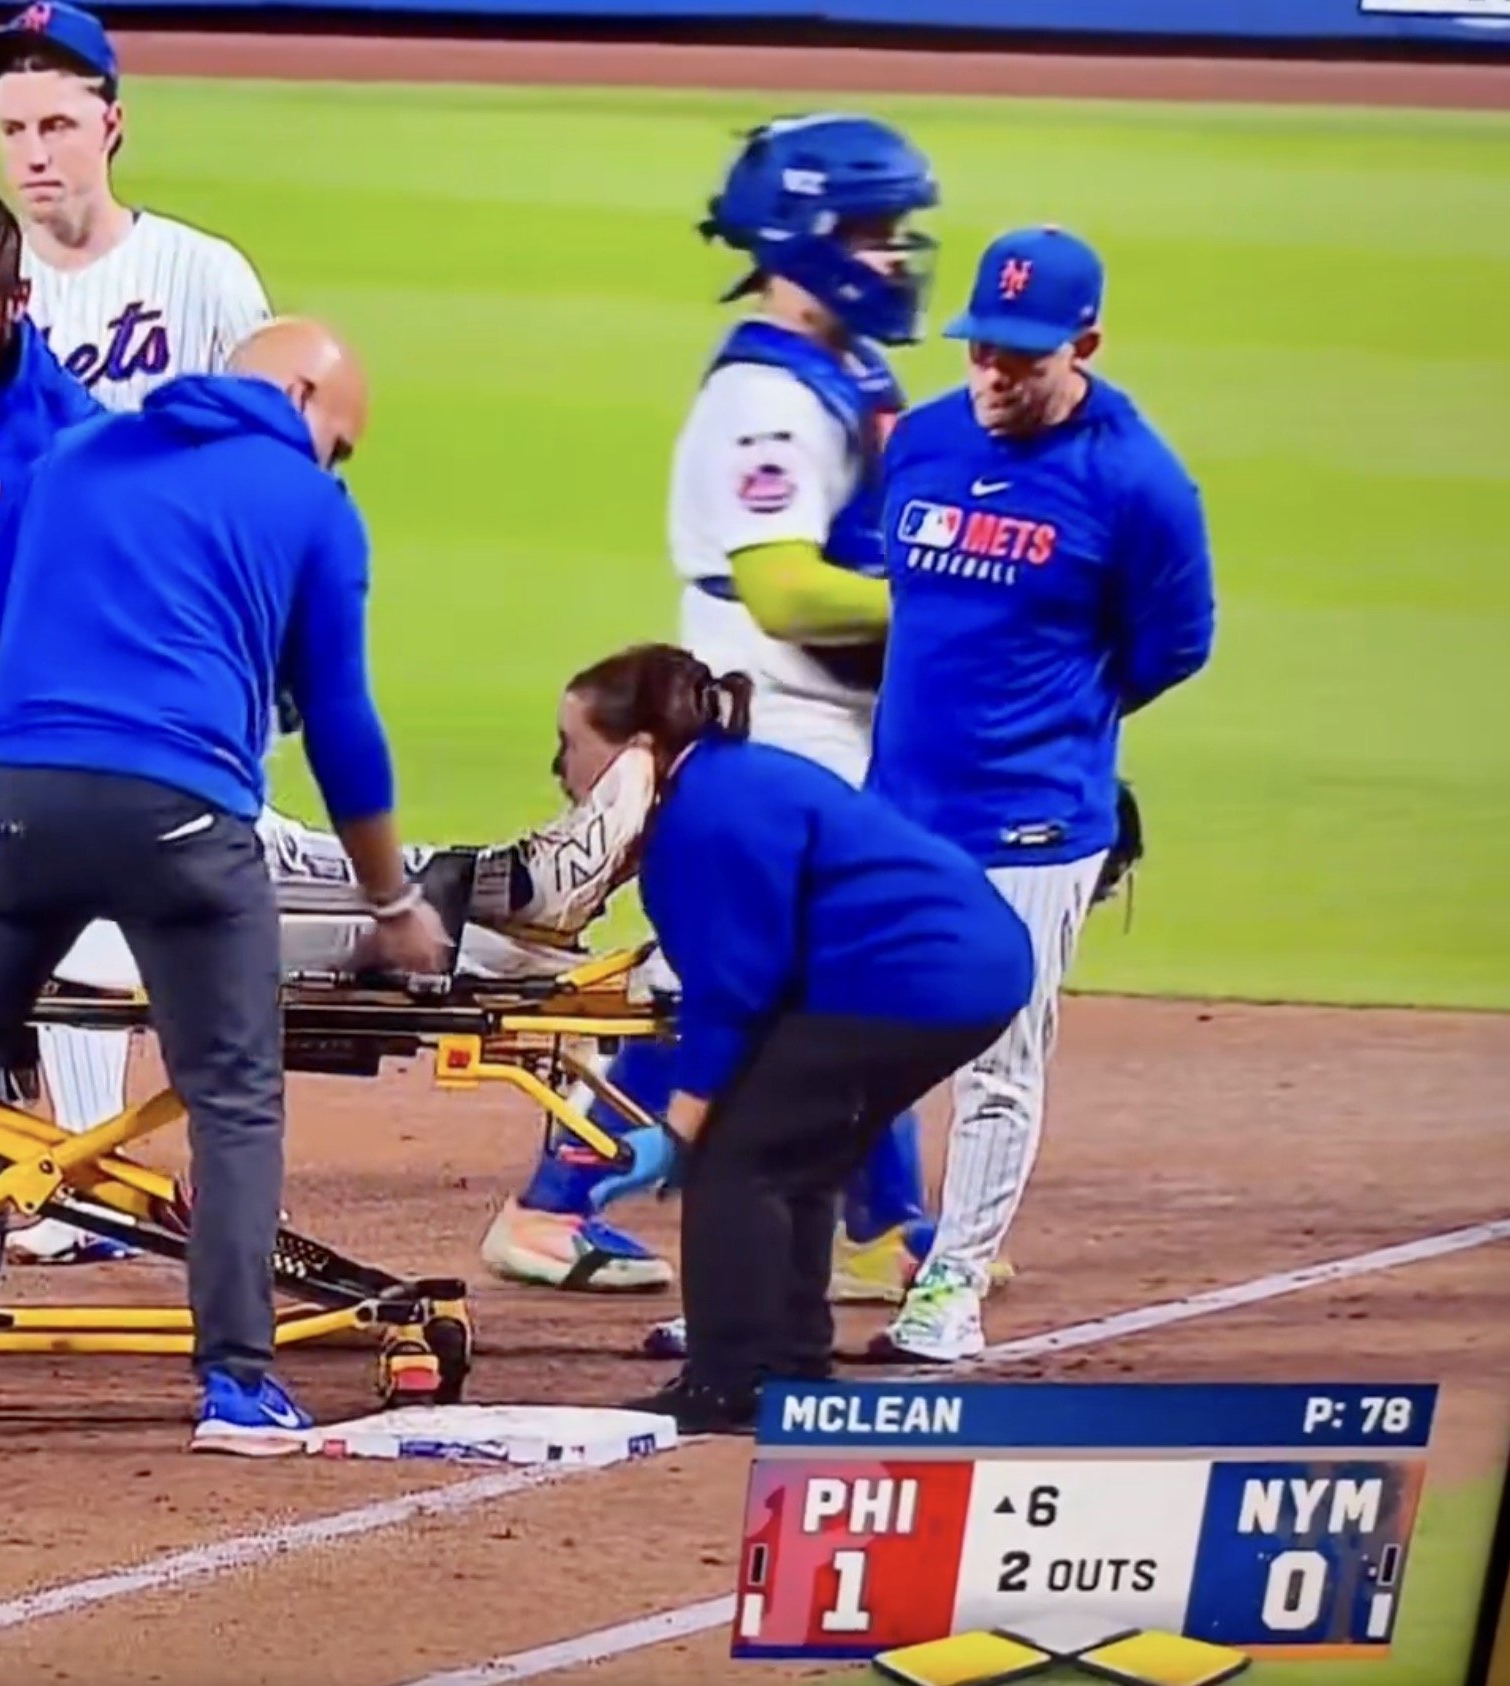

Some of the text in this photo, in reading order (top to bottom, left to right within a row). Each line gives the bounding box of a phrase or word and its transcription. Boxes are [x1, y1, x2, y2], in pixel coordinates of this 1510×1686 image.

[43, 301, 170, 387] ets
[960, 512, 1057, 565] METS
[782, 1395, 962, 1434] MCLEAN
[1303, 1397, 1412, 1434] P: 78
[803, 1478, 918, 1534] PHI
[1027, 1485, 1060, 1528] 6
[1237, 1478, 1382, 1534] NYM
[821, 1551, 870, 1631] 1
[997, 1551, 1158, 1592] 2 OUTS
[1261, 1550, 1328, 1631] 0
